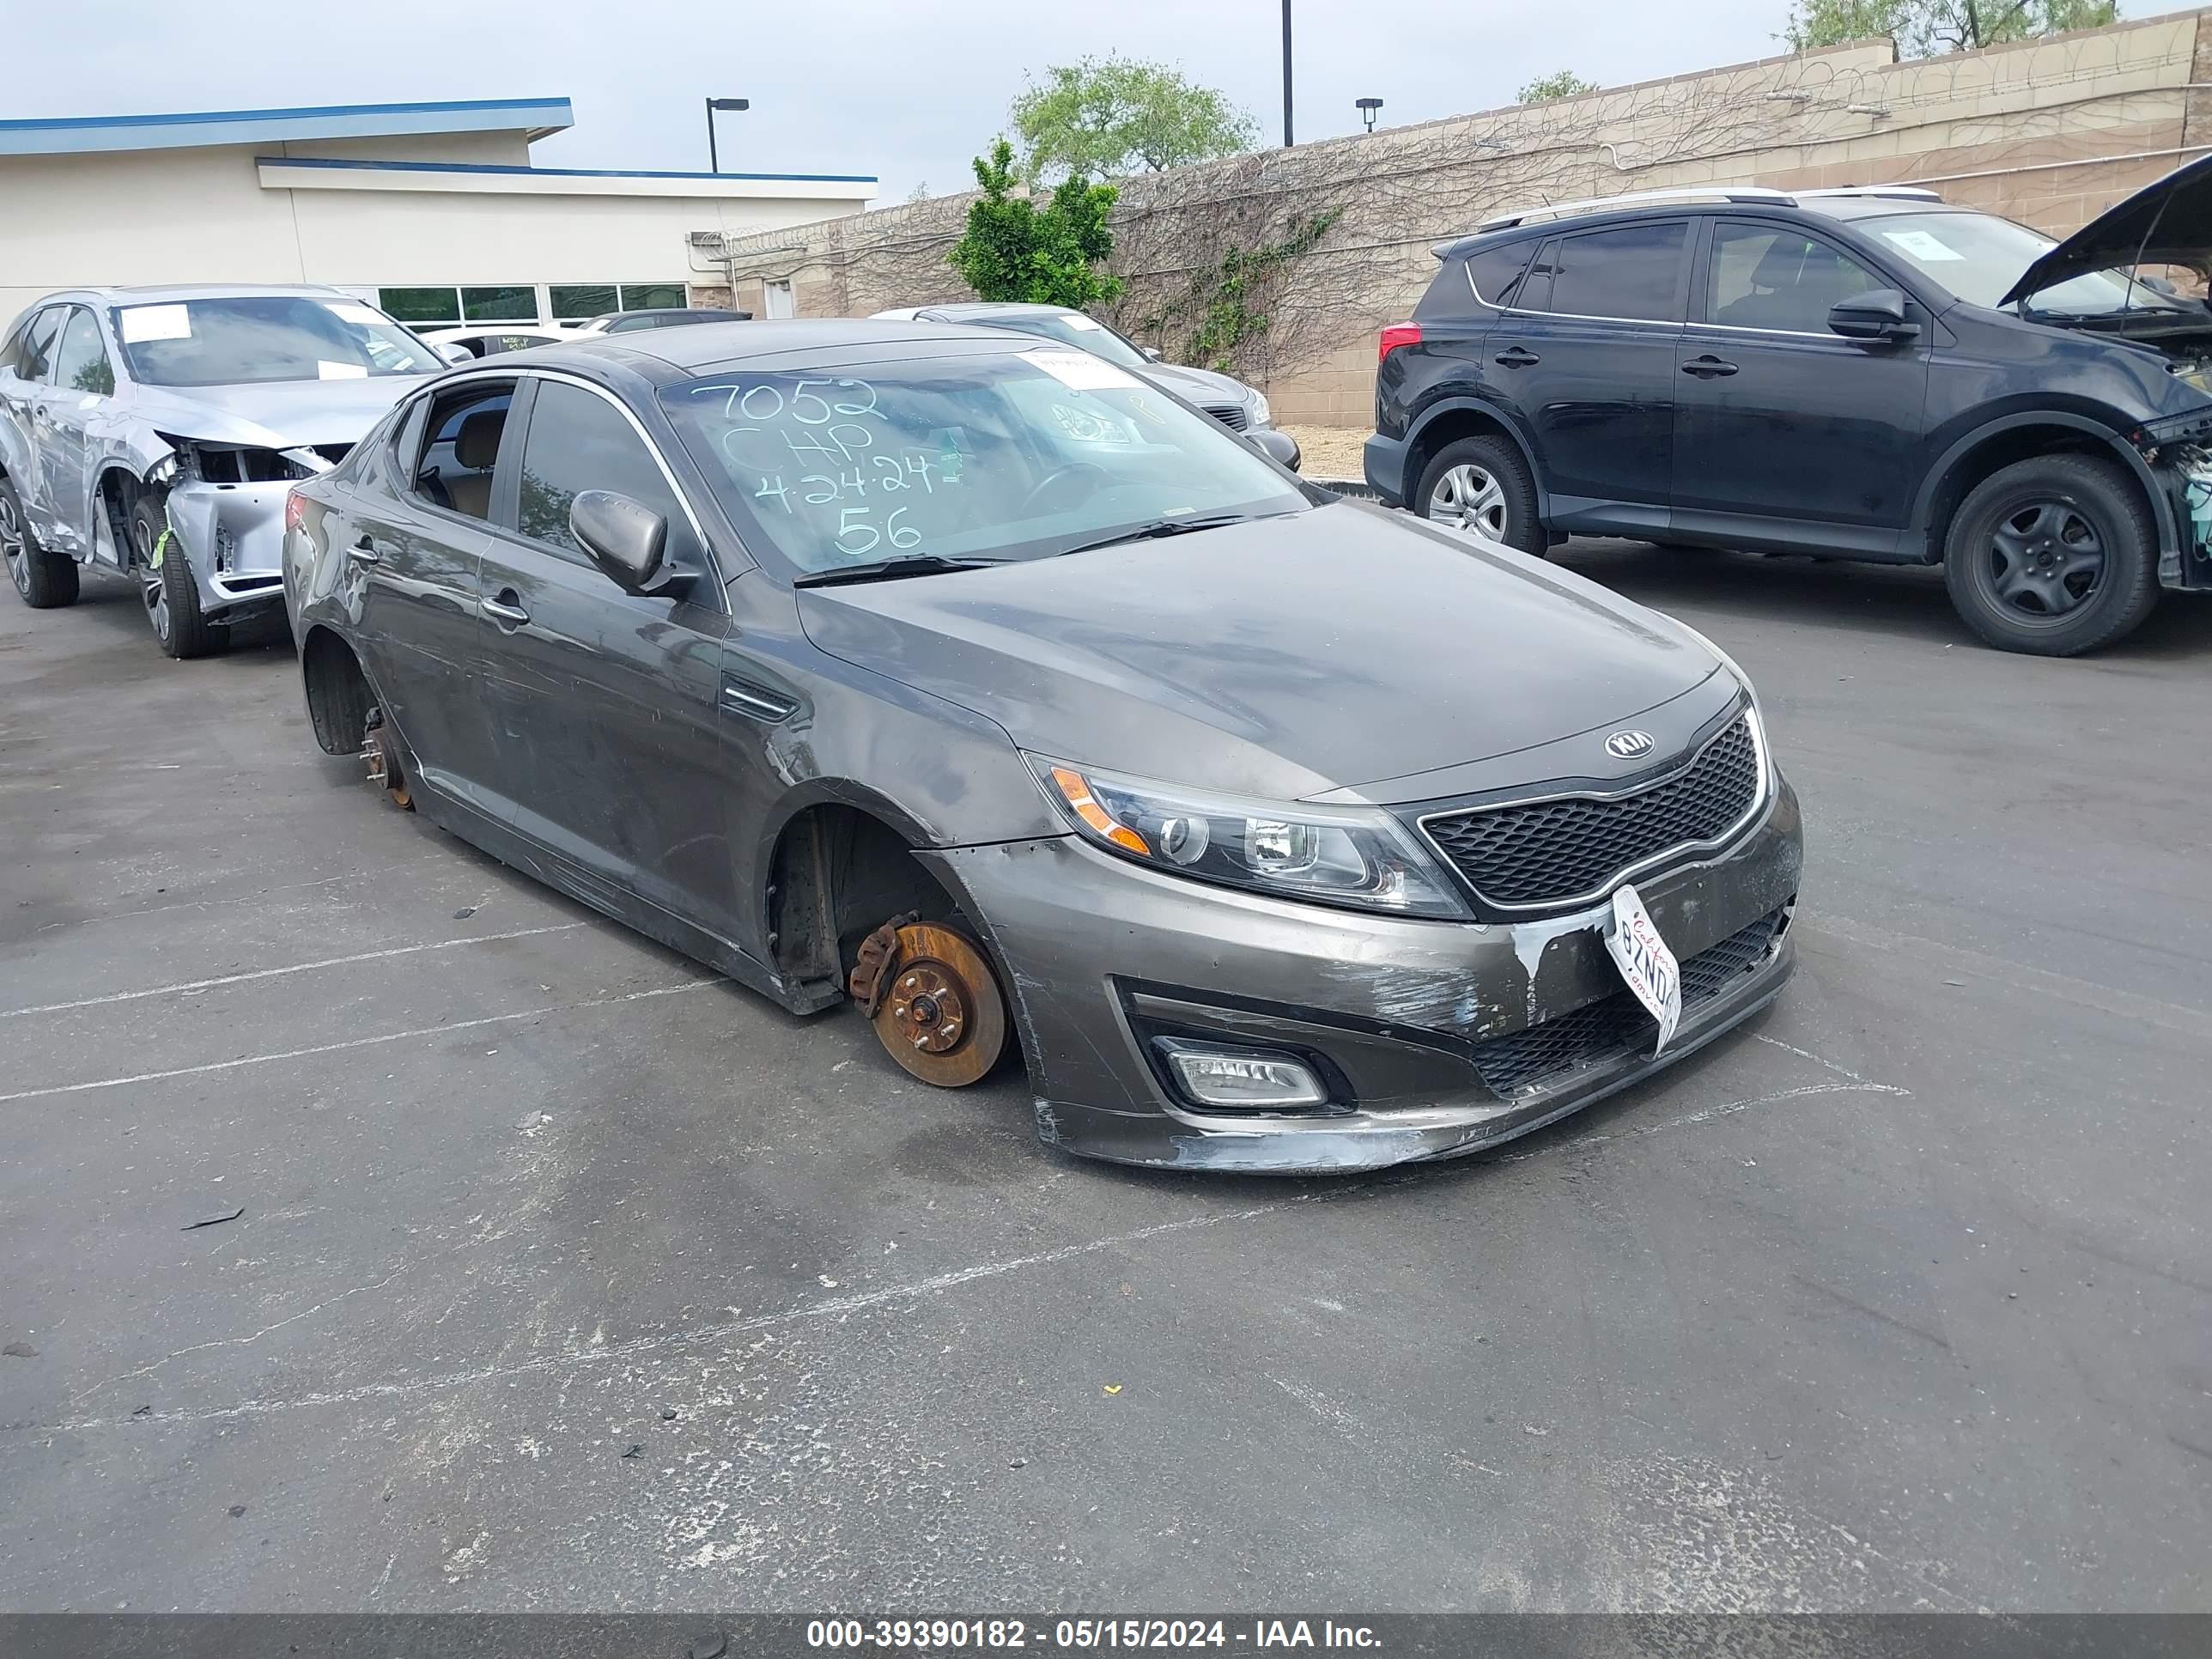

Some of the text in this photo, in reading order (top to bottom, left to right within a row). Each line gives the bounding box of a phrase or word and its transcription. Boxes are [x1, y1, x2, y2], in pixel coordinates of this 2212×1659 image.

[690, 378, 888, 424] 7052
[722, 424, 872, 471] CHP
[1610, 732, 1652, 754] KIA
